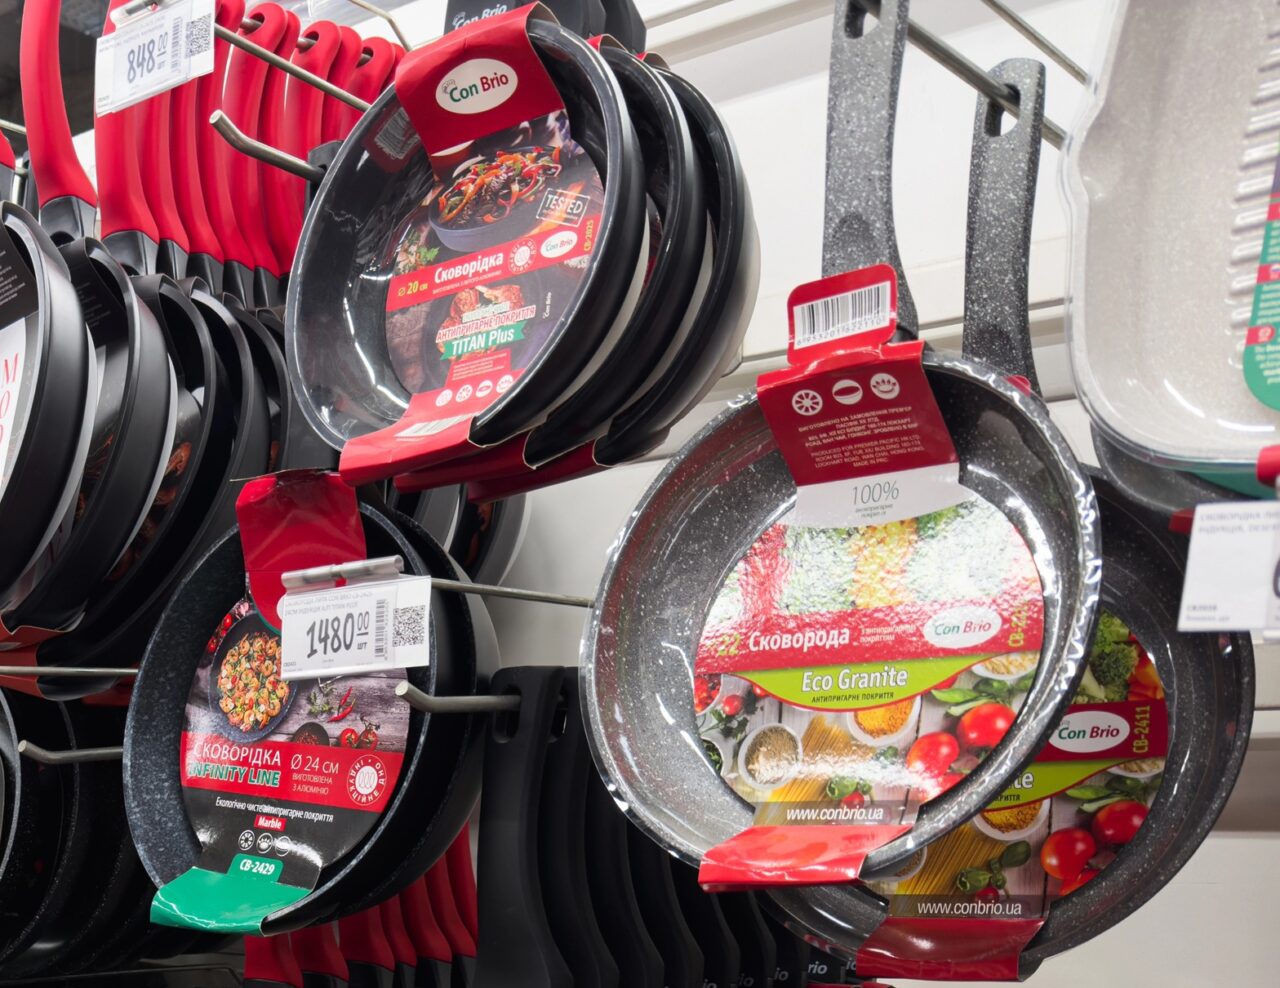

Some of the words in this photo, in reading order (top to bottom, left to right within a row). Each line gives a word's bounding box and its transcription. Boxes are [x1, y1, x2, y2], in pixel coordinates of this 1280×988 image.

[127, 38, 156, 84] 848
[449, 83, 479, 103] Con
[480, 73, 509, 92] Brio
[544, 194, 583, 213] TESTED
[434, 253, 504, 284] Сковорідка
[406, 281, 419, 294] 20
[452, 334, 485, 356] TITAN
[488, 328, 514, 346] Plus
[852, 481, 900, 505] 100%
[306, 613, 355, 658] 1480
[357, 611, 369, 631] 00
[748, 626, 850, 652] Сковорода
[933, 622, 961, 636] Con
[962, 618, 992, 635] Brio
[801, 672, 834, 692] Eco
[838, 666, 909, 691] Granite
[811, 694, 860, 704] АНТИПРИГАРНЕ
[861, 691, 894, 701] ПОКРИТТЯ
[1057, 725, 1086, 741] Con
[1089, 724, 1120, 739] Brio
[1132, 705, 1151, 754] CB-2411
[194, 742, 281, 767] СКОВОРІДКА
[305, 755, 320, 772] 24
[322, 761, 340, 774] СМ
[188, 762, 245, 785] INFINITY
[248, 768, 281, 788] LINE
[292, 773, 333, 784] ВИГОТОВЛЕНА
[216, 797, 246, 809] Екологічно
[305, 811, 334, 822] покриття
[786, 805, 884, 820] www.conbrio.ua
[257, 817, 282, 830] Marble
[239, 859, 275, 875] CB-2429
[918, 901, 1022, 915] www.conbrio.ua
